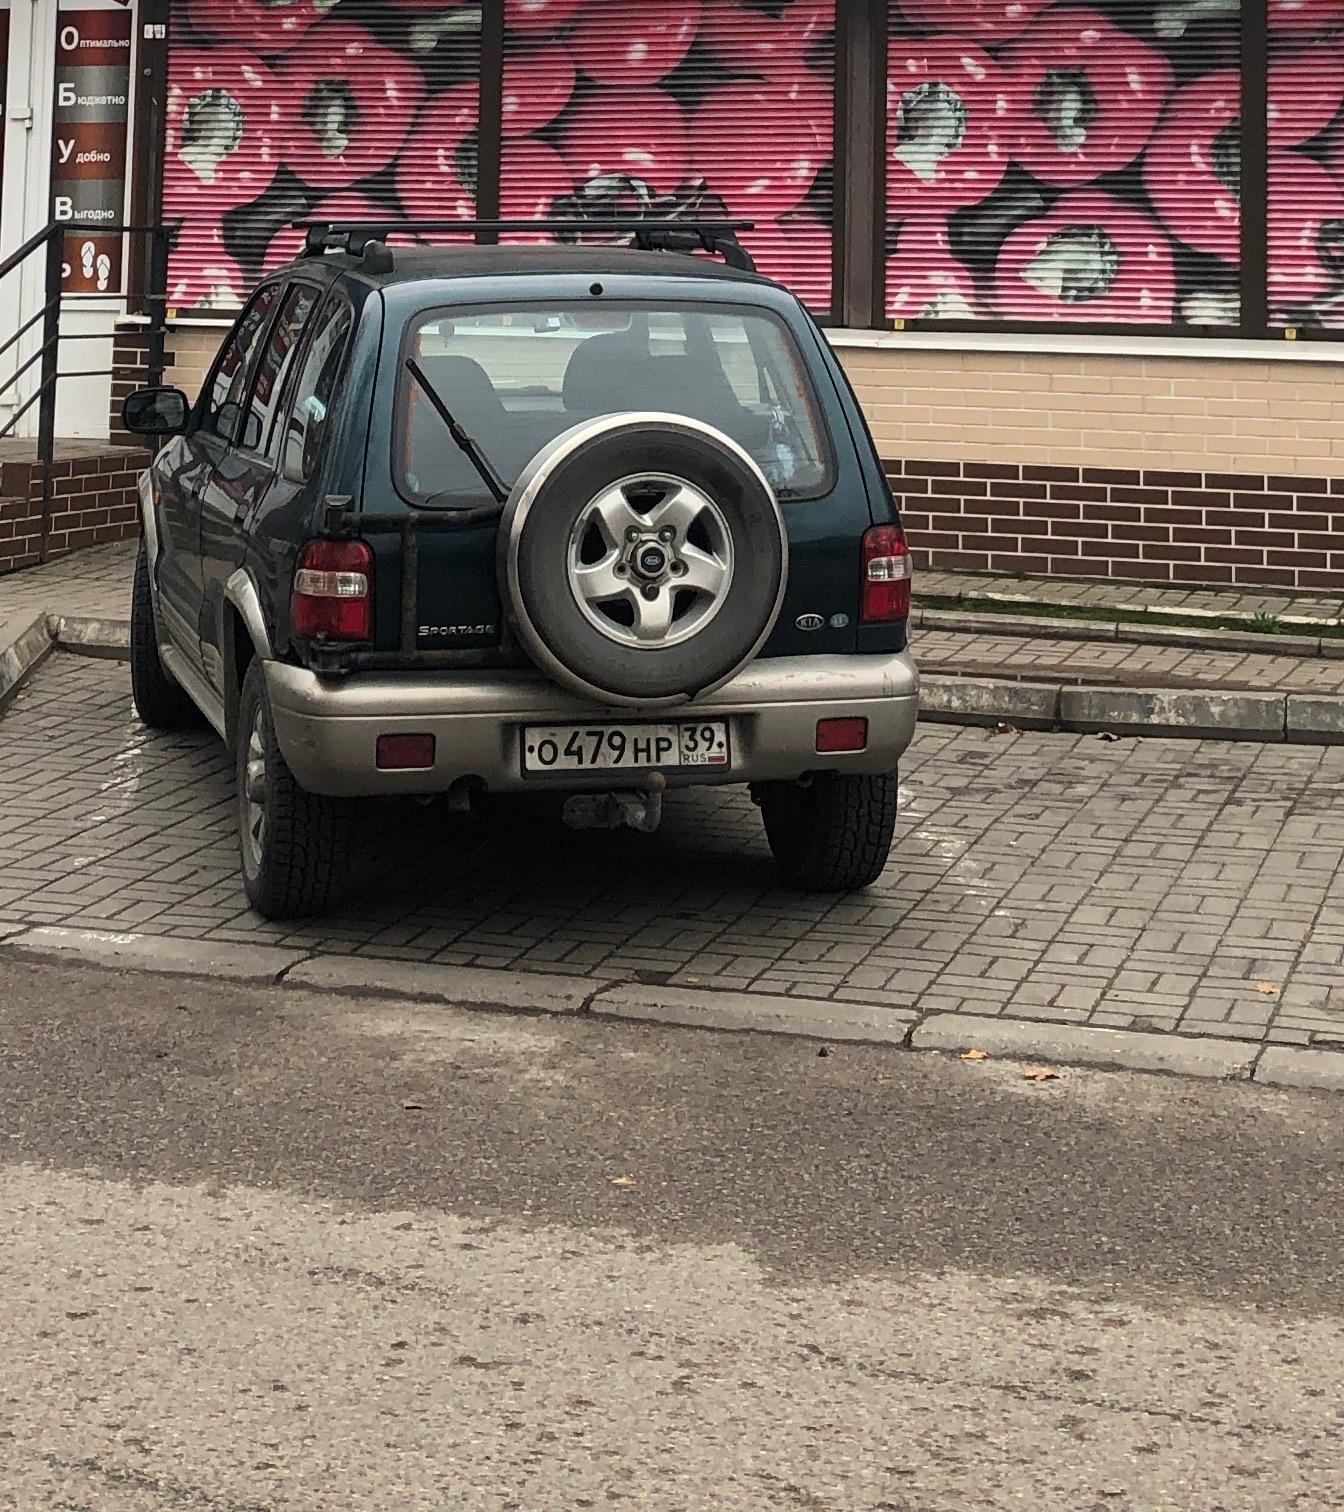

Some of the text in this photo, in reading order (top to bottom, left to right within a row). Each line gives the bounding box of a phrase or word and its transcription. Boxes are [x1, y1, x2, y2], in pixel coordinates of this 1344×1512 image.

[800, 617, 820, 628] KIA
[537, 730, 673, 765] О479НР
[683, 726, 716, 753] 39
[683, 752, 707, 764] RUS
